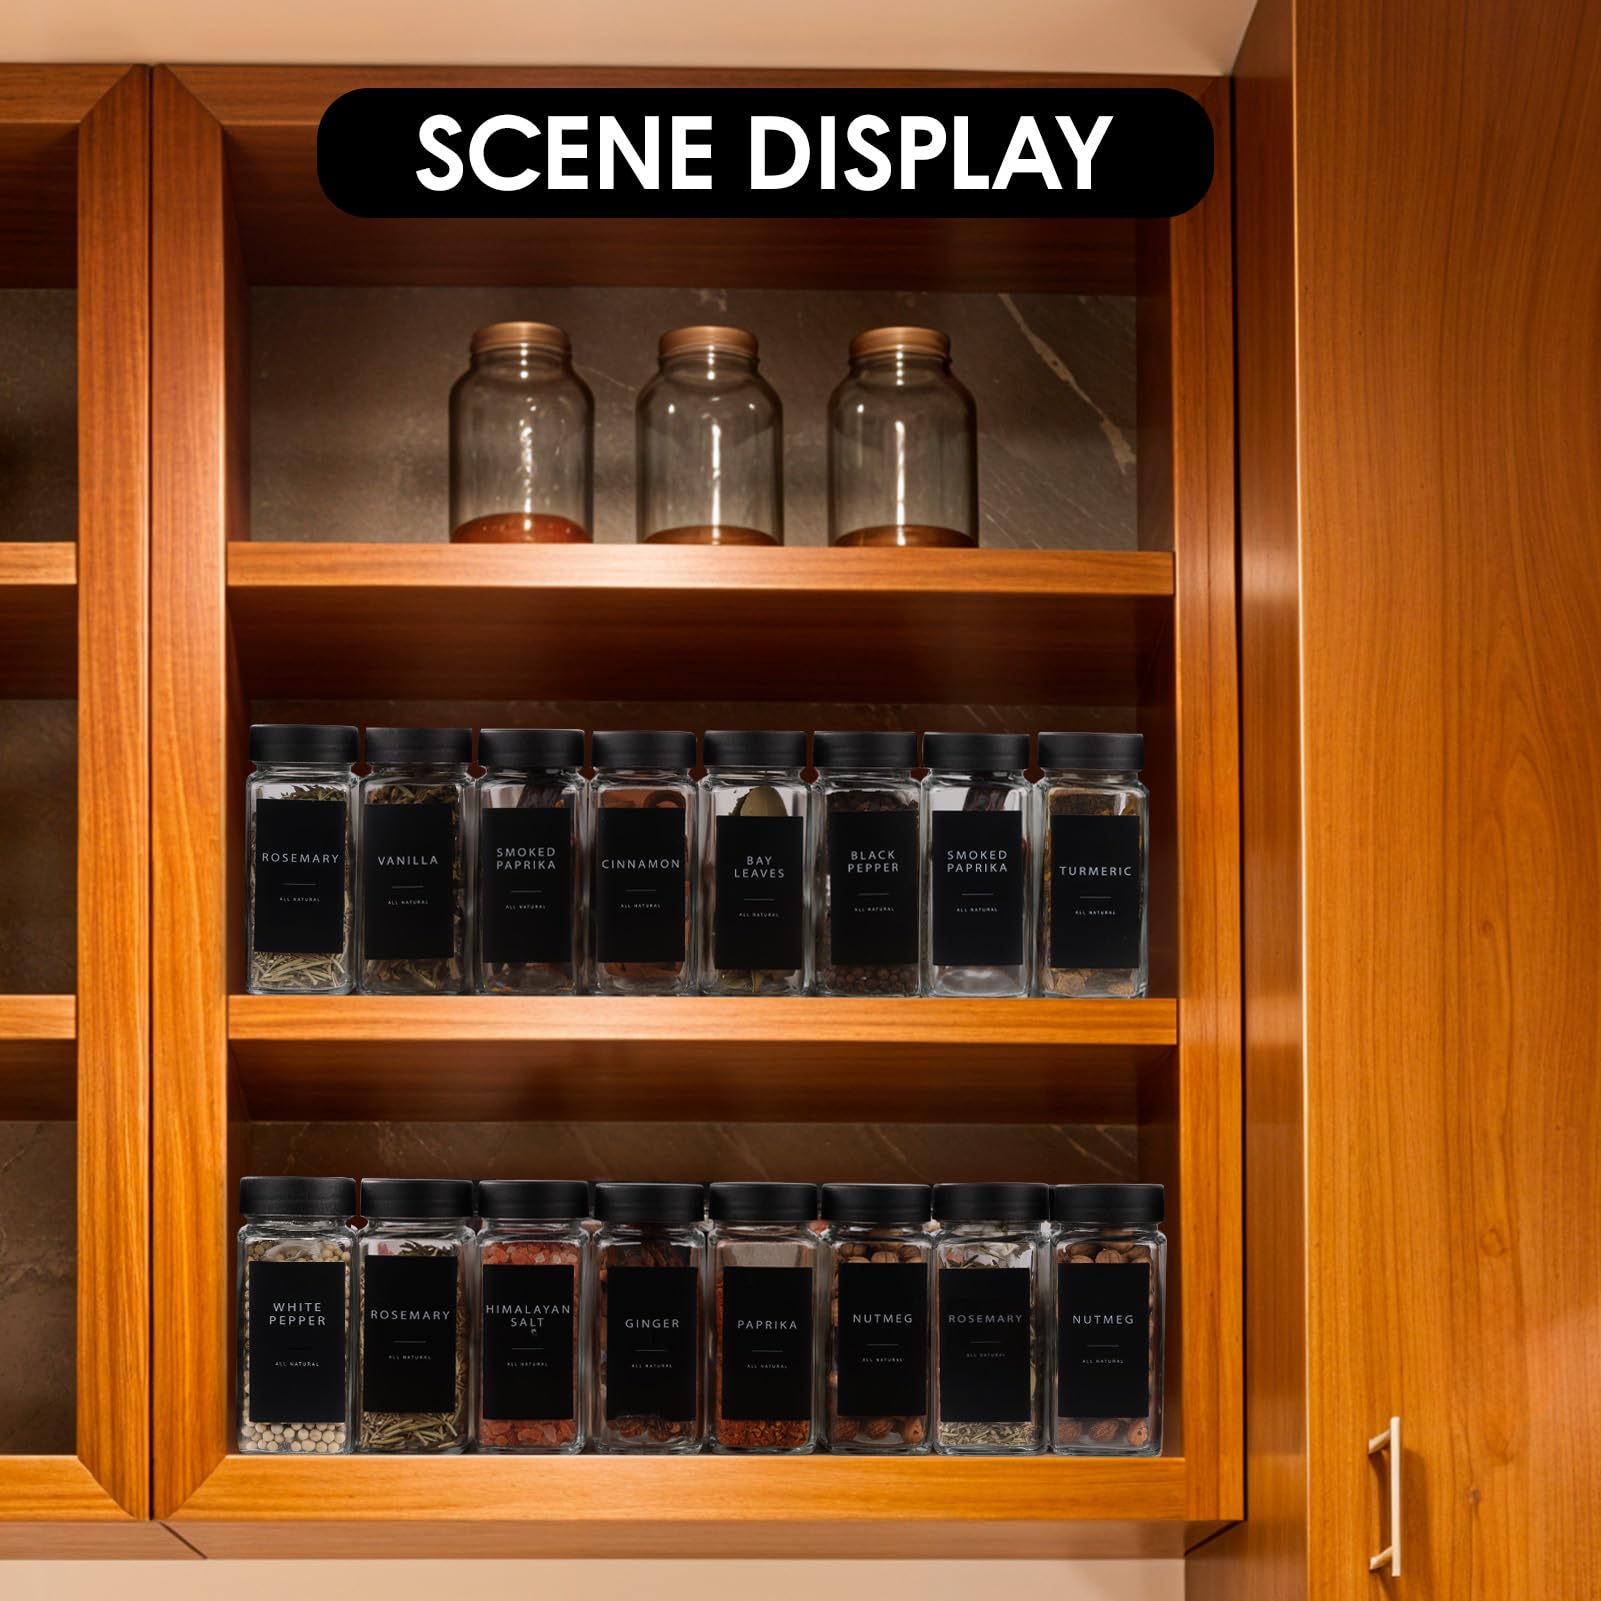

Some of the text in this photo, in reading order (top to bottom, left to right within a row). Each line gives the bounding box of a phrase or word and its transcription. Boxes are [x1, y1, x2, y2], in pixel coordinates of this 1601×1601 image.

[496, 846, 556, 858] SMOKED
[850, 849, 896, 861] BLACK
[947, 849, 1008, 861] SMOKED
[261, 852, 339, 864] ROSEMARY
[377, 855, 439, 866] VANILLA
[746, 855, 772, 866] BAY
[496, 859, 556, 871] PAPRIKA
[601, 858, 680, 870] CINNAMON
[847, 862, 899, 874] PEPPER
[946, 862, 1008, 873] PAPRIKA
[734, 868, 785, 879] LEAVES
[1058, 865, 1132, 877] TURMERIC
[272, 1302, 322, 1313] WHITE
[485, 1304, 570, 1315] HIMALAYAN
[269, 1315, 326, 1326] PEPPER
[370, 1309, 450, 1321] ROSEMARY
[852, 1313, 913, 1324] NUTMEG
[948, 1314, 1023, 1324] ROSEMARY
[1072, 1314, 1134, 1325] NUTMEG
[510, 1317, 545, 1328] SALT
[624, 1318, 680, 1329] GINGER
[737, 1319, 798, 1330] PAPRIKA
